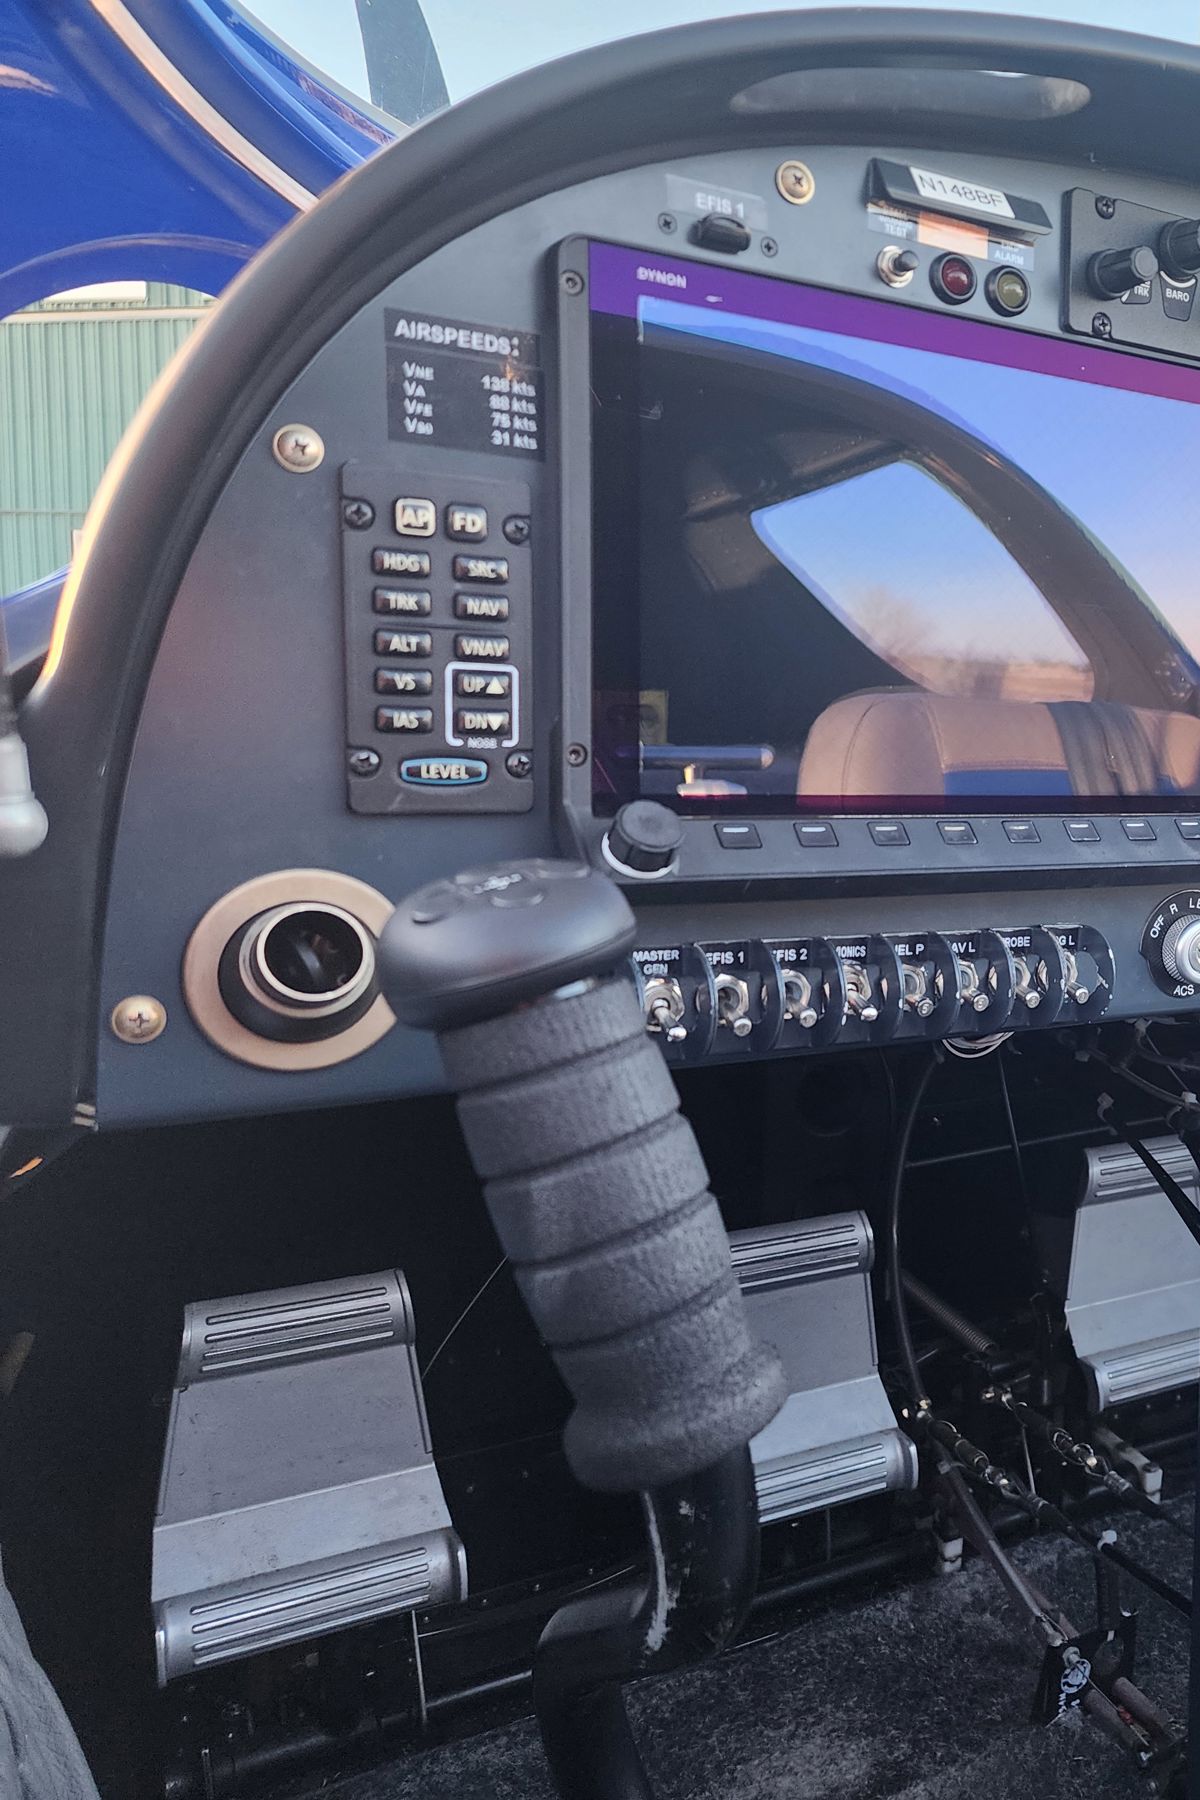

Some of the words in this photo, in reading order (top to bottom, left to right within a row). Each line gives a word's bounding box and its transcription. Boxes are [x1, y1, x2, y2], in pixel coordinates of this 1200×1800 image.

[918, 175, 1002, 207] N148BF
[696, 192, 731, 215] EFIS
[736, 202, 744, 218] 1
[994, 251, 1024, 265] ALARM
[637, 266, 687, 288] DYNON
[1166, 288, 1190, 302] BARO
[394, 318, 519, 357] AIRSPEEDS:
[511, 378, 536, 397] kts
[511, 396, 537, 414] kts
[490, 412, 511, 428] 75
[512, 414, 538, 432] kts
[491, 430, 510, 446] 31
[512, 431, 538, 450] kts
[401, 507, 429, 527] AP
[453, 513, 480, 533] FD
[383, 553, 420, 573] HDG
[388, 594, 418, 611] TRK
[467, 599, 500, 617] NAV
[389, 636, 419, 653] ALT
[462, 639, 502, 657] VNAV
[394, 674, 416, 691] VS
[463, 676, 485, 693] UP
[393, 713, 418, 730] IAS
[465, 714, 487, 730] DN
[421, 764, 469, 780] LEVEL
[1169, 903, 1178, 915] R
[1189, 898, 1195, 909] L
[1150, 914, 1164, 938] OFF
[951, 942, 968, 954] AV
[969, 942, 976, 953] L
[1002, 936, 1031, 949] ROBE
[1069, 935, 1075, 946] L
[632, 949, 680, 962] MASTER
[705, 952, 734, 966] EFIS
[738, 951, 744, 963] 1
[773, 949, 797, 962] FIS
[800, 948, 808, 960] 2
[897, 945, 913, 956] EL
[916, 944, 924, 955] P
[643, 963, 668, 976] GEN
[1174, 984, 1195, 996] ACS
